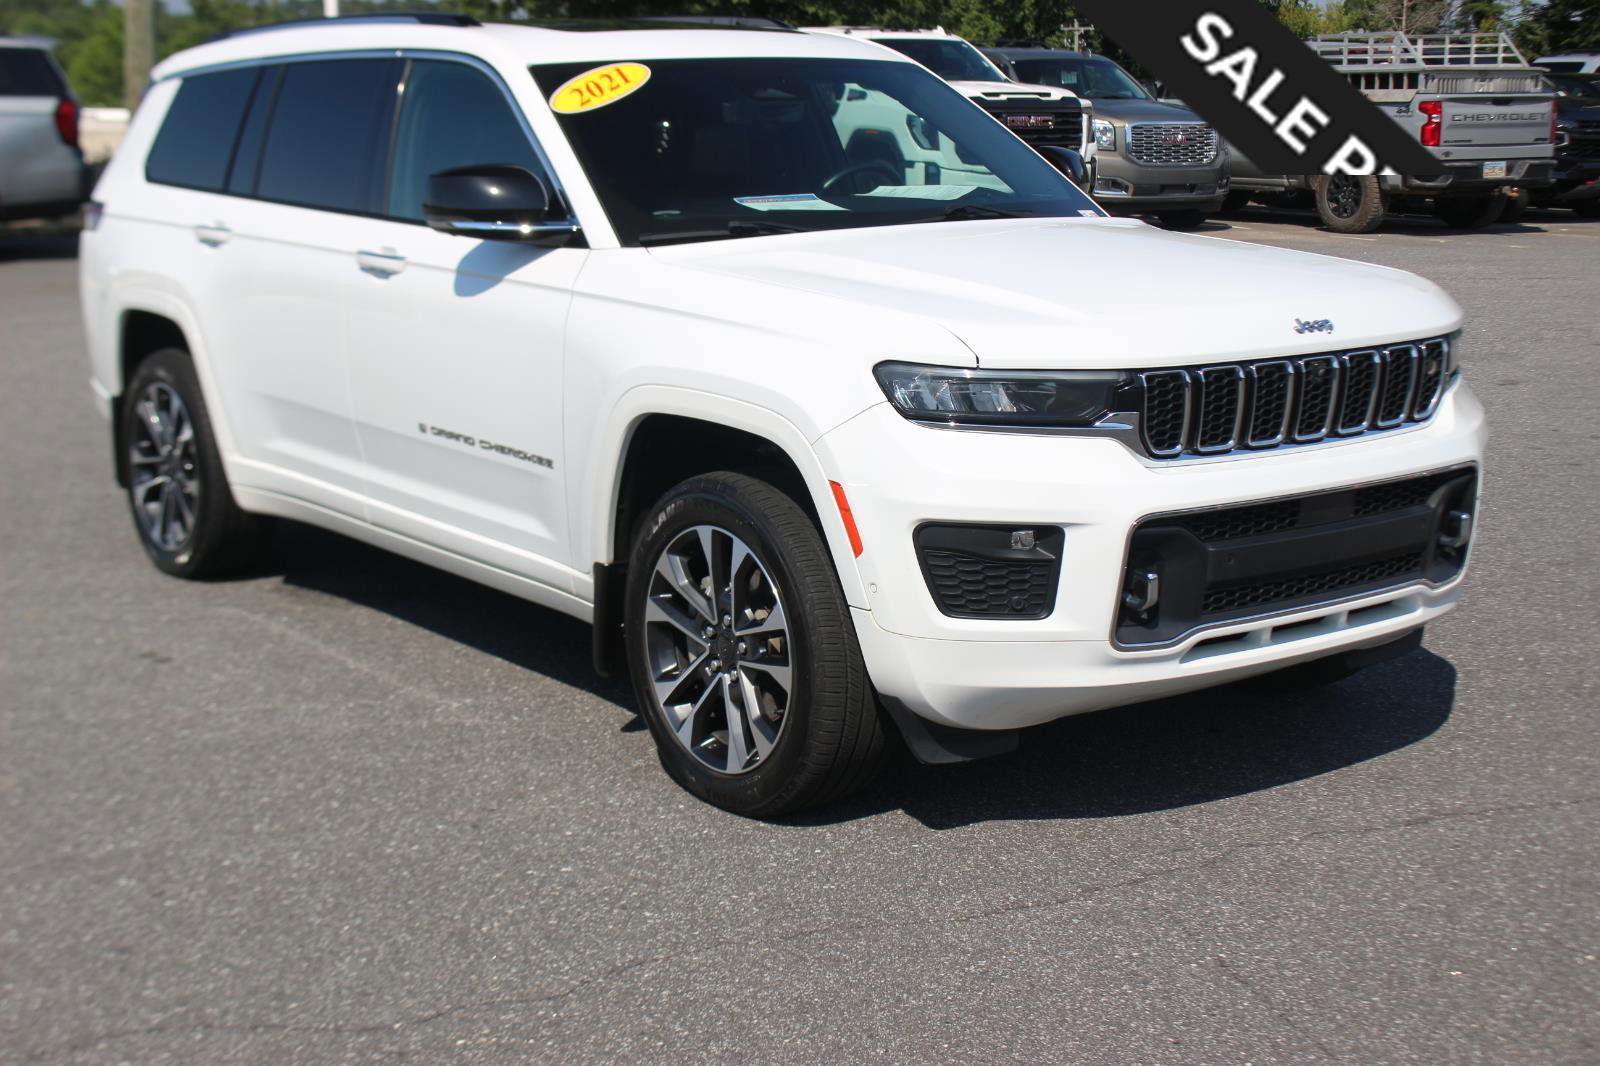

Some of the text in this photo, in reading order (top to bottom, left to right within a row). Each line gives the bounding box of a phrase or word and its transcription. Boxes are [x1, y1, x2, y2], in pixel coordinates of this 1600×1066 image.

[570, 66, 630, 106] 2021
[1451, 112, 1546, 122] CHEVROLET
[1293, 318, 1334, 335] Jeep
